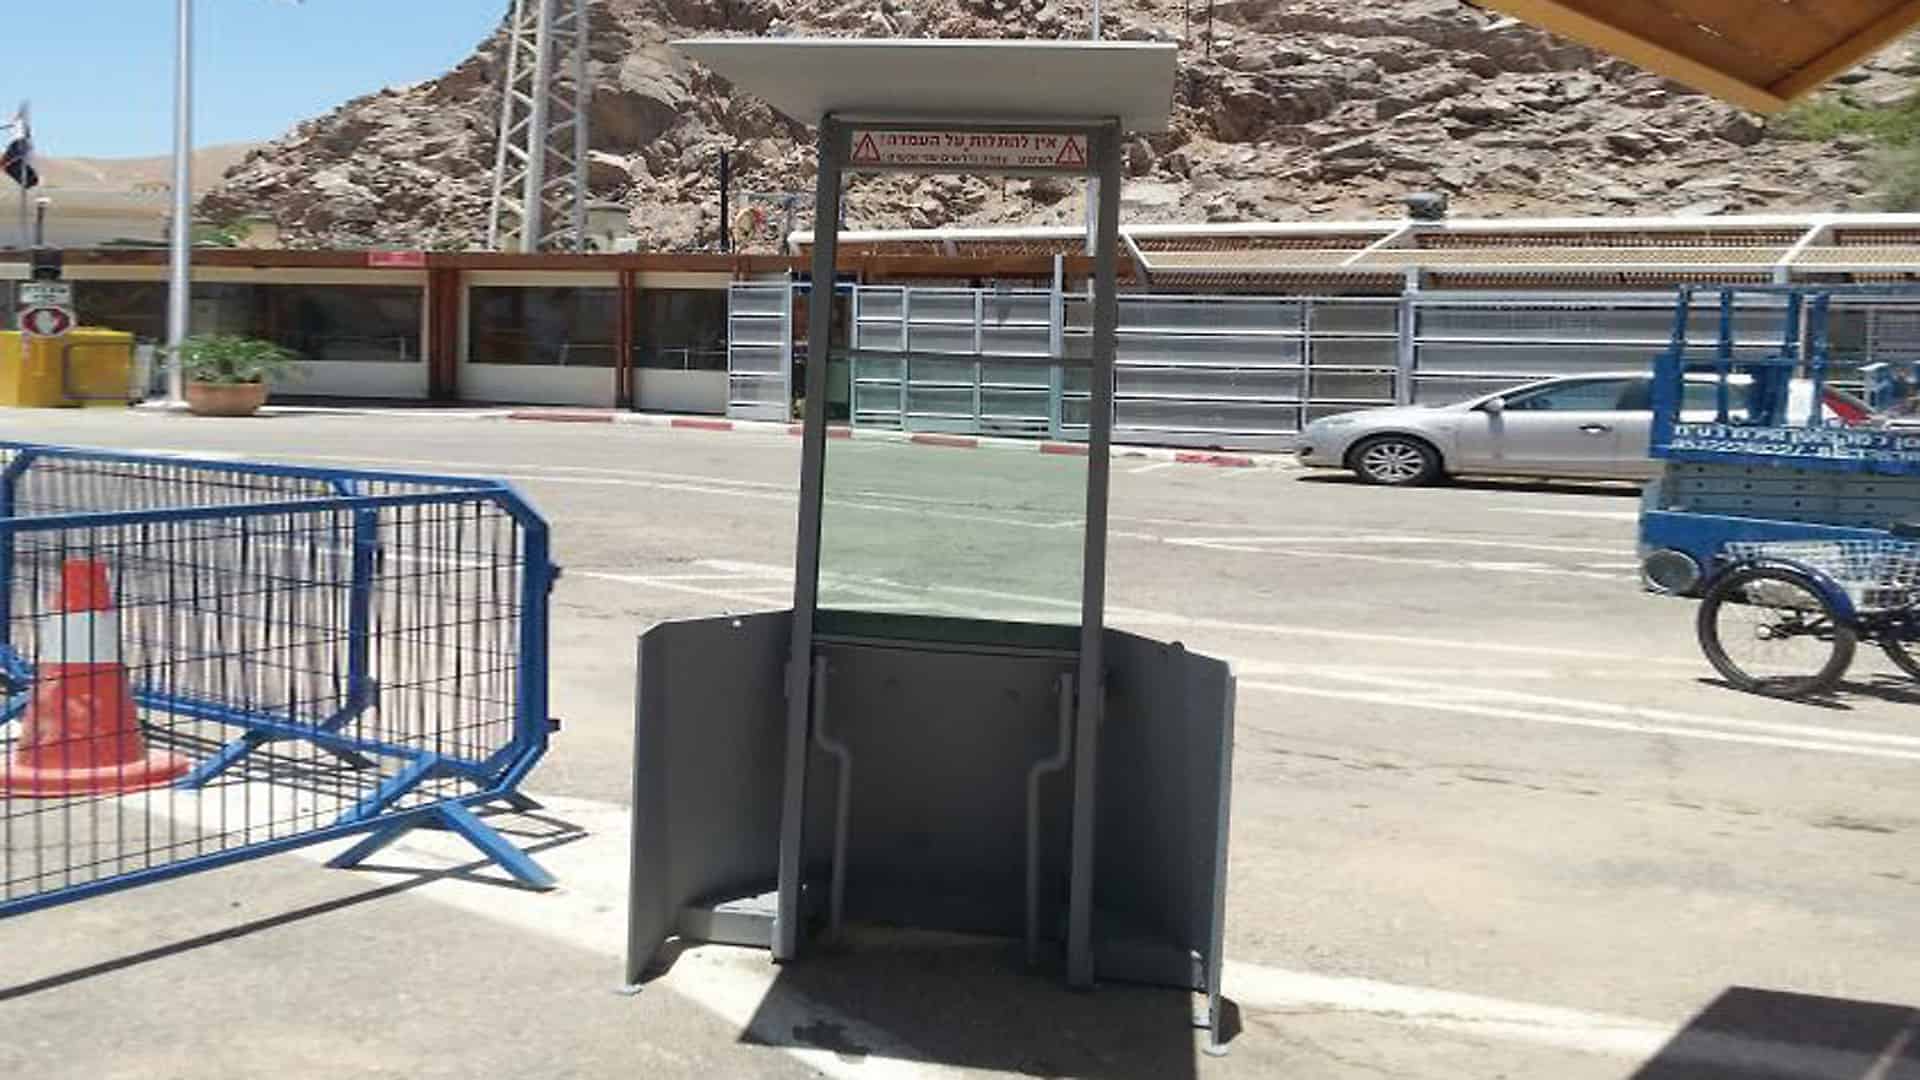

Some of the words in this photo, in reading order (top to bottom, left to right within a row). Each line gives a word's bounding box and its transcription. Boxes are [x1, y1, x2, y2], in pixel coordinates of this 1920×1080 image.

[945, 133, 965, 146] על
[969, 133, 1029, 148] להתלות
[1035, 135, 1057, 150] אין
